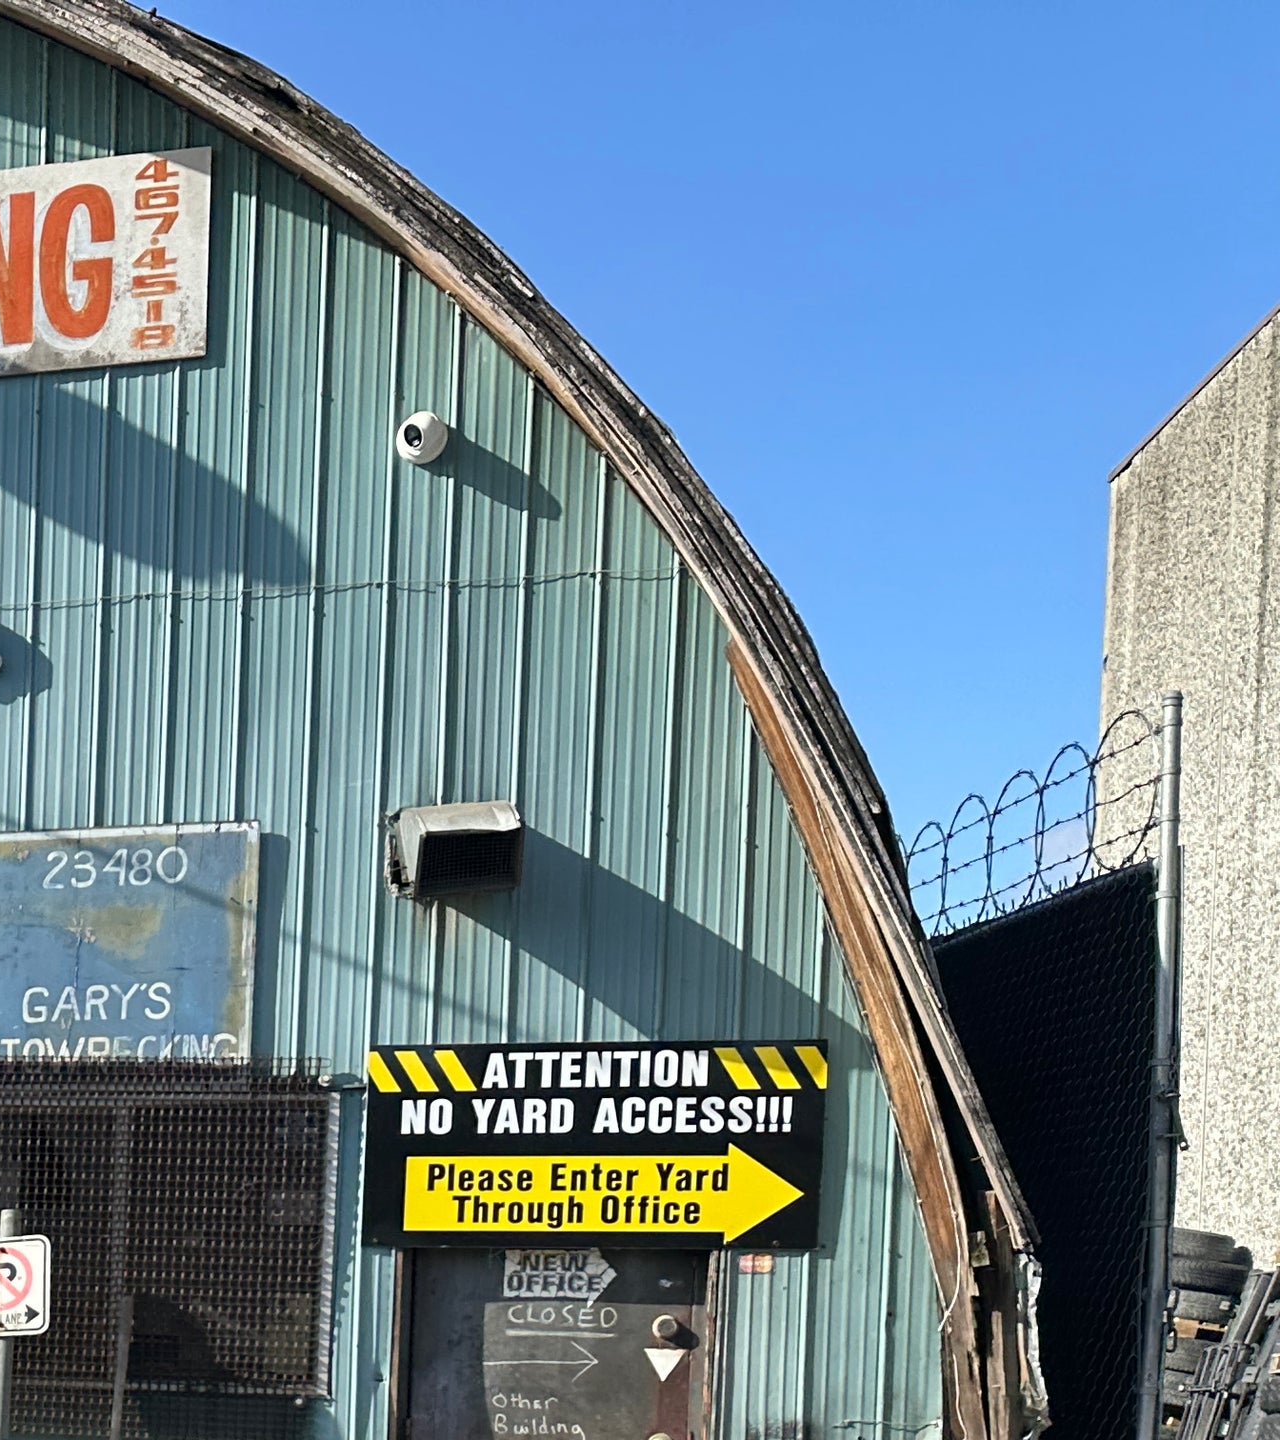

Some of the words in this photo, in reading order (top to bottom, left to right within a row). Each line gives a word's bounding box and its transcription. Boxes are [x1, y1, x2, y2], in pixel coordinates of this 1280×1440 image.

[42, 846, 189, 890] 23480
[22, 982, 172, 1024] GARY'S
[482, 1050, 710, 1089] ATTENTION
[400, 1099, 453, 1135] NO
[472, 1098, 575, 1134] YARD
[593, 1096, 793, 1134] ACCESS!!!
[427, 1163, 533, 1191] Please
[550, 1163, 639, 1191] Enter
[655, 1163, 729, 1191] Yard
[452, 1195, 584, 1229] Through
[600, 1195, 701, 1224] Office
[520, 1253, 588, 1272] NEW
[507, 1272, 602, 1293] OFFICE
[507, 1304, 618, 1328] CLOSED
[491, 1393, 558, 1410] Other
